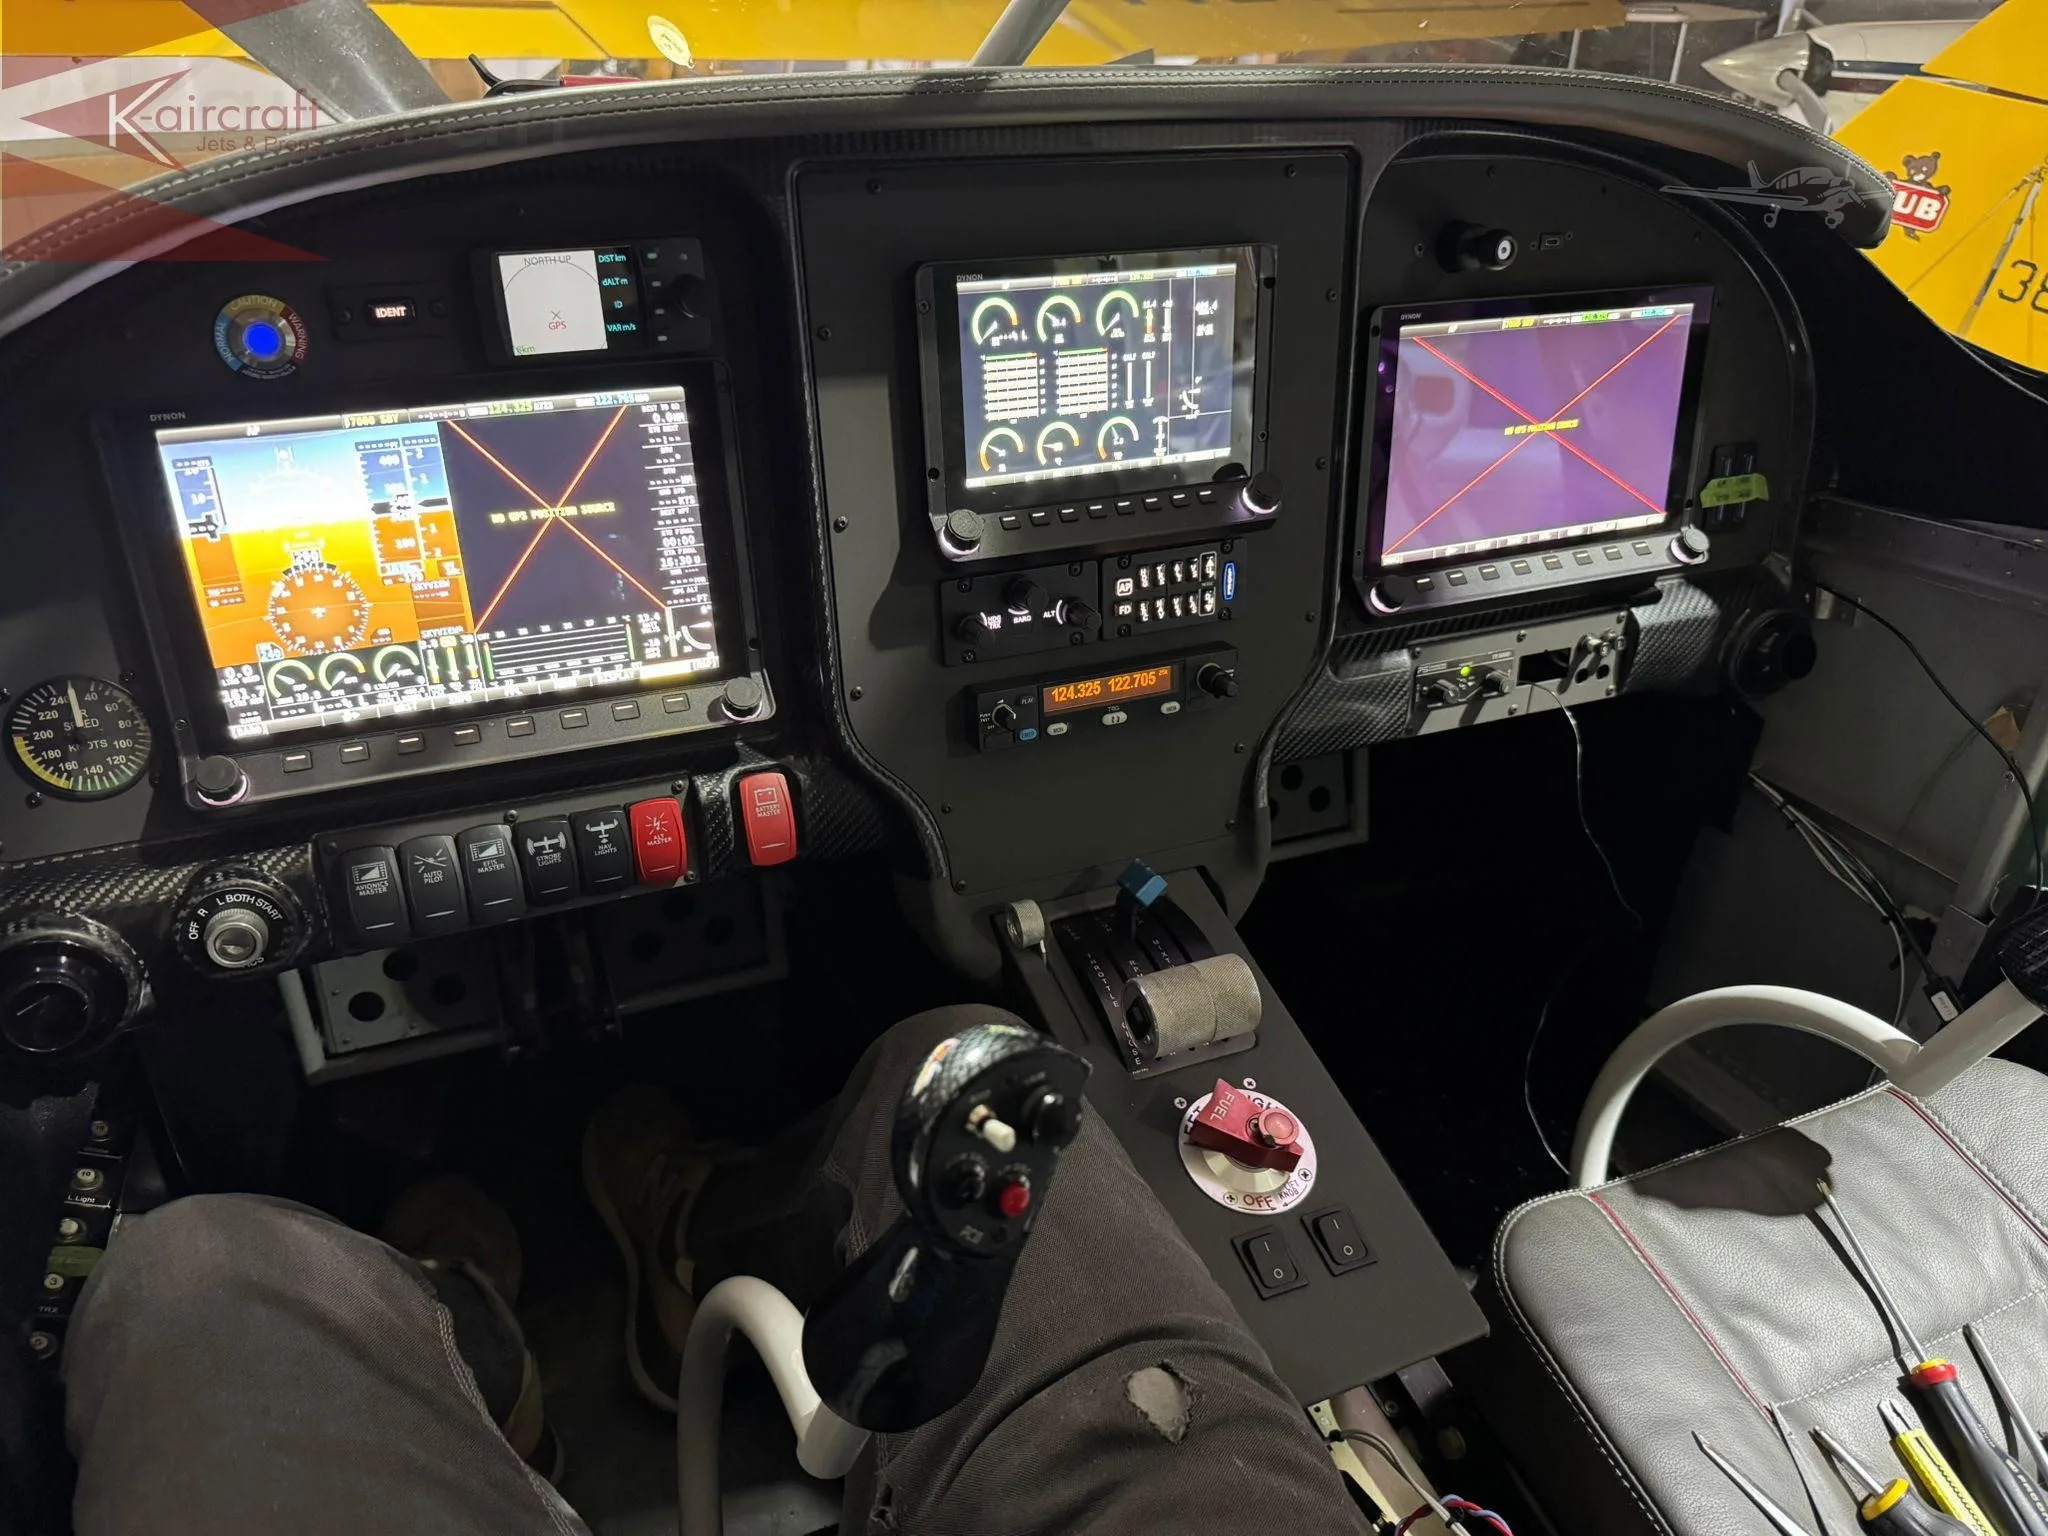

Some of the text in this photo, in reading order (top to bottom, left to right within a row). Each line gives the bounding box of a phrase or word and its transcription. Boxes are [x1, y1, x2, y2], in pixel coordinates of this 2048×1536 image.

[1893, 190, 1942, 222] UB
[524, 255, 572, 266] NORTH UP
[598, 254, 627, 264] DIST km
[602, 277, 621, 286] dALT
[956, 274, 983, 282] DYNON
[231, 294, 278, 311] CAUTION
[614, 300, 623, 309] ID
[374, 305, 406, 318] IDENT
[548, 321, 567, 330] GPS
[607, 322, 637, 332] VAR m/s
[289, 312, 307, 360] WARNING
[216, 322, 234, 363] NORMAL
[149, 411, 186, 422] DYNON
[1119, 582, 1131, 592] AP
[1043, 610, 1056, 619] ALT
[1118, 605, 1132, 615] FD
[1013, 615, 1032, 624] BARO
[1052, 670, 1157, 702] 124.325 122.705
[85, 692, 98, 702] 40
[104, 702, 119, 713] 60
[37, 710, 59, 721] 220
[118, 719, 132, 729] 80
[33, 730, 54, 741] 200
[113, 739, 134, 750] 100
[41, 749, 62, 760] 180
[58, 760, 79, 771] 160
[106, 755, 127, 766] 120
[83, 764, 104, 776] 140
[755, 804, 781, 814] BATTERY
[757, 808, 781, 818] MASTER
[646, 836, 673, 846] MASTER
[594, 847, 618, 856] LIGHTS
[598, 844, 612, 852] NAV
[536, 852, 562, 861] STROBE
[483, 859, 498, 867] EFIS
[537, 857, 562, 867] LIGHTS
[477, 863, 506, 874] MASTER
[423, 870, 443, 879] AUTO
[424, 876, 443, 885] PILOT
[355, 880, 389, 892] AVIONICS
[359, 887, 388, 897] MASTER
[216, 897, 225, 906] L
[225, 893, 256, 904] BOTH
[197, 908, 209, 918] R
[255, 898, 283, 921] START
[188, 921, 201, 940] OFF
[1086, 953, 1120, 1008] THROTTLE
[1210, 1091, 1235, 1121] FUEL
[1284, 1179, 1300, 1191] LIFT
[1278, 1188, 1299, 1200] KNOB
[75, 1196, 95, 1204] Light
[1243, 1193, 1273, 1208] OFF
